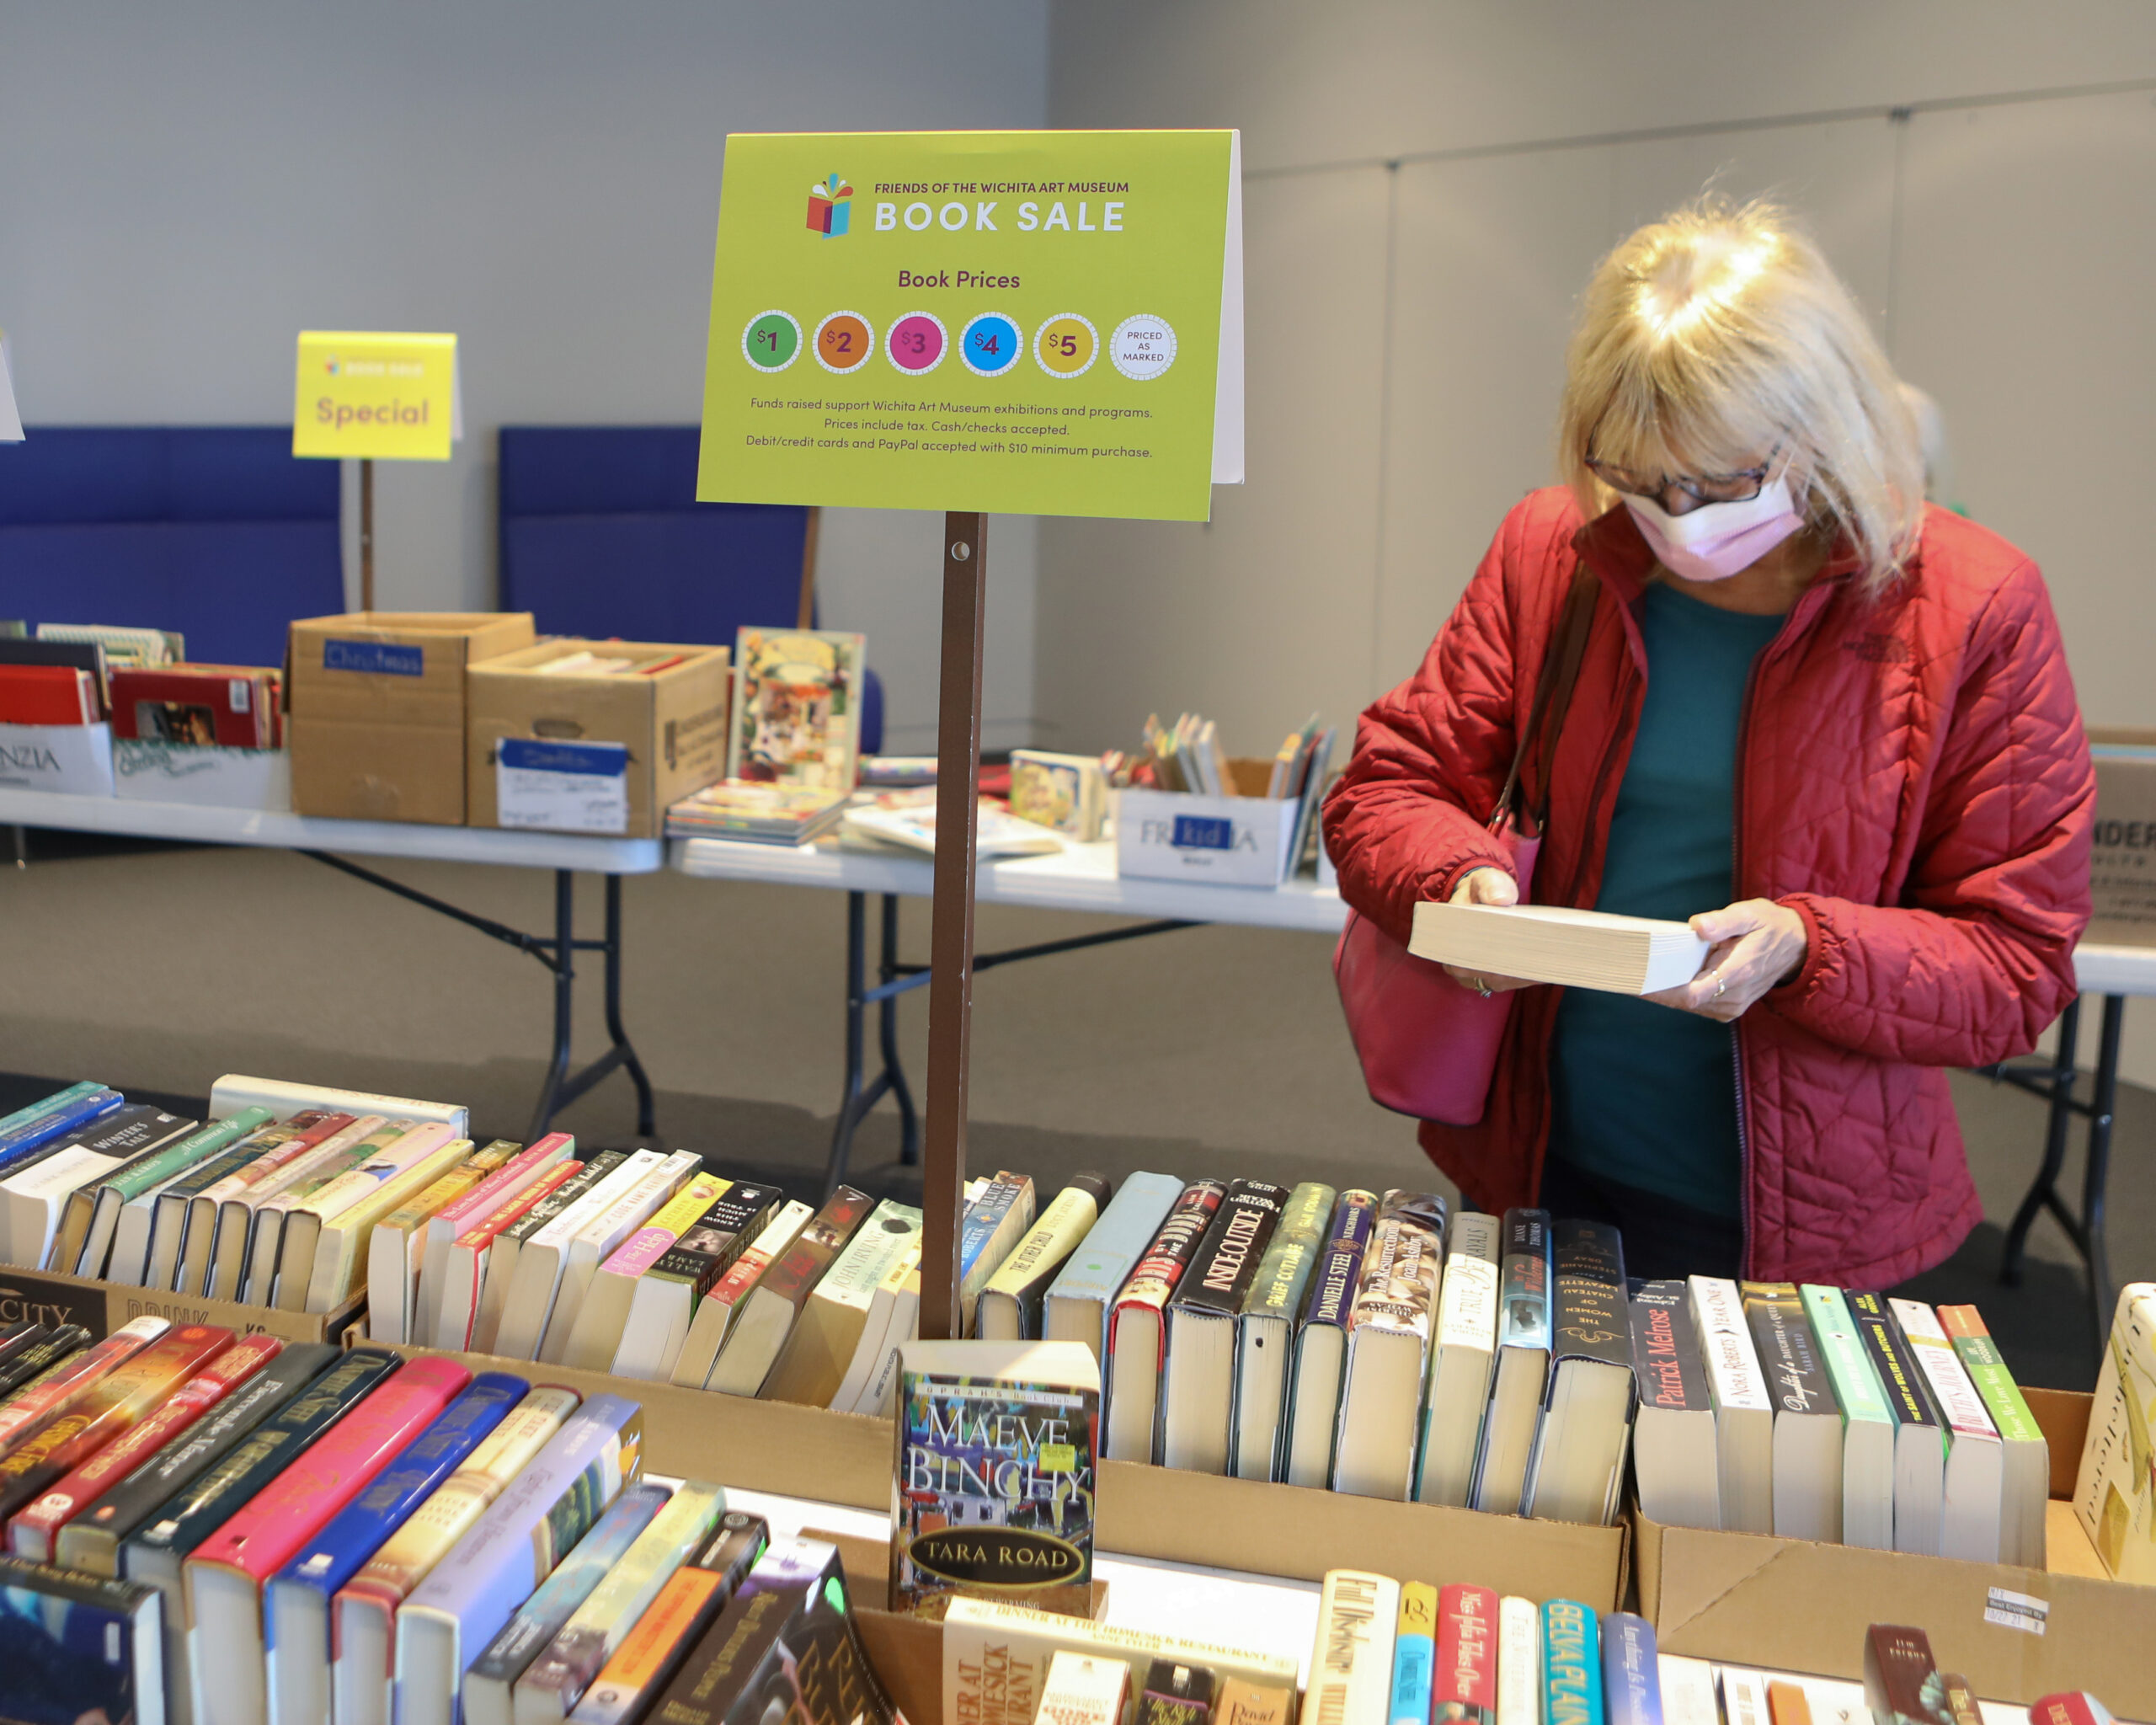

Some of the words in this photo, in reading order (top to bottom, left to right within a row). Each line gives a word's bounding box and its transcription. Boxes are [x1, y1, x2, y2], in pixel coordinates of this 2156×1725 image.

[874, 183, 928, 194] FRIENDS
[932, 183, 949, 194] OF
[953, 183, 977, 193] THE
[980, 183, 1036, 193] WICHITA
[1038, 182, 1065, 193] ART
[1067, 182, 1129, 193] MUSEUM
[874, 201, 998, 232] BOOK
[1017, 201, 1125, 232] SALE
[898, 270, 950, 288] Book
[957, 270, 1021, 288] Prices
[756, 329, 777, 352] $1
[825, 330, 851, 354] $2
[901, 330, 926, 354] $3
[974, 332, 1000, 355] $4
[1049, 334, 1077, 357] $5
[1127, 331, 1163, 340] PRICED
[1137, 342, 1150, 351] AS
[1123, 352, 1165, 361] MARKED
[316, 398, 430, 430] Special
[750, 398, 783, 409] Funds
[787, 399, 822, 410] raised
[825, 401, 870, 413] support
[873, 401, 915, 412] Wichita
[918, 402, 937, 412] Art
[939, 403, 990, 413] Museum
[994, 403, 1059, 415] exhibitions
[1061, 405, 1086, 416] and
[1089, 408, 1153, 420] programs.
[825, 419, 858, 430] Prices
[862, 419, 904, 430] include
[907, 420, 928, 431] tax.
[931, 421, 1007, 434] Cash/checks
[1010, 425, 1070, 437] accepted.
[746, 435, 814, 447] Debit/credit
[817, 438, 849, 448] cards
[851, 439, 875, 449] and
[878, 439, 919, 452] PayPal
[921, 441, 977, 454] accepted
[980, 442, 1005, 453] with
[1008, 443, 1027, 454] $10
[1031, 444, 1088, 457] minimum
[1091, 446, 1153, 458] purchase.
[326, 643, 420, 673] Christmas
[93, 1121, 149, 1150] WINTER'S
[119, 1132, 151, 1148] TALE
[718, 1200, 742, 1210] TRUE
[980, 1183, 1006, 1207] BLUE
[995, 1183, 1021, 1211] SMOKE
[703, 1215, 734, 1226] KNOW
[718, 1207, 747, 1216] MUCH
[1342, 1206, 1361, 1239] NEIGHBORS
[625, 1248, 643, 1262] The
[634, 1232, 670, 1253] Help
[962, 1228, 986, 1259] ROBERTS
[1167, 1242, 1183, 1257] THE
[1372, 1224, 1400, 1278] Resurrection
[668, 1254, 707, 1267] LAMB
[831, 1262, 861, 1290] JOHN
[853, 1231, 886, 1263] IRVING
[1009, 1260, 1032, 1273] THE
[1276, 1243, 1305, 1281] COTTAGE
[1329, 1253, 1352, 1278] STEEL
[1398, 1258, 1422, 1285] Joan
[1561, 1263, 1616, 1274] STEPHANIE
[1266, 1281, 1289, 1307] GRIEF
[1317, 1275, 1348, 1321] DANIELLE
[1369, 1279, 1388, 1294] The
[1558, 1280, 1619, 1292] LAFAYETTE
[1563, 1289, 1614, 1299] CHATEAU
[1706, 1289, 1726, 1306] ONE
[1, 1298, 72, 1326] CITY
[1460, 1288, 1483, 1315] TRUE
[1566, 1307, 1613, 1318] WOMEN
[1578, 1316, 1599, 1325] THE
[1712, 1306, 1732, 1327] YEAR
[1644, 1308, 1677, 1357] Melrose
[1872, 1324, 1892, 1354] BUTCHERS
[1720, 1338, 1750, 1370] ROBERTS
[1656, 1359, 1686, 1407] Patrick
[1731, 1365, 1754, 1397] NORA
[1888, 1362, 1907, 1386] WOLVES
[1983, 1368, 2001, 1385] Most
[926, 1386, 1003, 1398] OPRAH'S
[1013, 1392, 1039, 1402] Book
[1901, 1392, 1919, 1413] SAINT
[1995, 1386, 2011, 1403] Love
[2002, 1404, 2016, 1416] We
[925, 1403, 1070, 1453] MAEVE
[2010, 1417, 2030, 1439] Those
[906, 1446, 1091, 1504] BINCHY
[924, 1541, 988, 1561] TARA
[999, 1546, 1069, 1568] ROAD
[1460, 1590, 1482, 1614] Miss
[996, 1605, 1049, 1623] DINNER
[1055, 1617, 1069, 1626] AT
[1074, 1619, 1097, 1632] THE
[1103, 1626, 1174, 1646] HOMESICK
[1179, 1639, 1268, 1662] RESTAURANT
[1449, 1613, 1487, 1639] Julia
[1548, 1604, 1585, 1664] BELVA
[1091, 1633, 1121, 1644] ANNE
[1458, 1639, 1483, 1668] Takes
[958, 1658, 981, 1686] AT
[1454, 1667, 1480, 1697] Over
